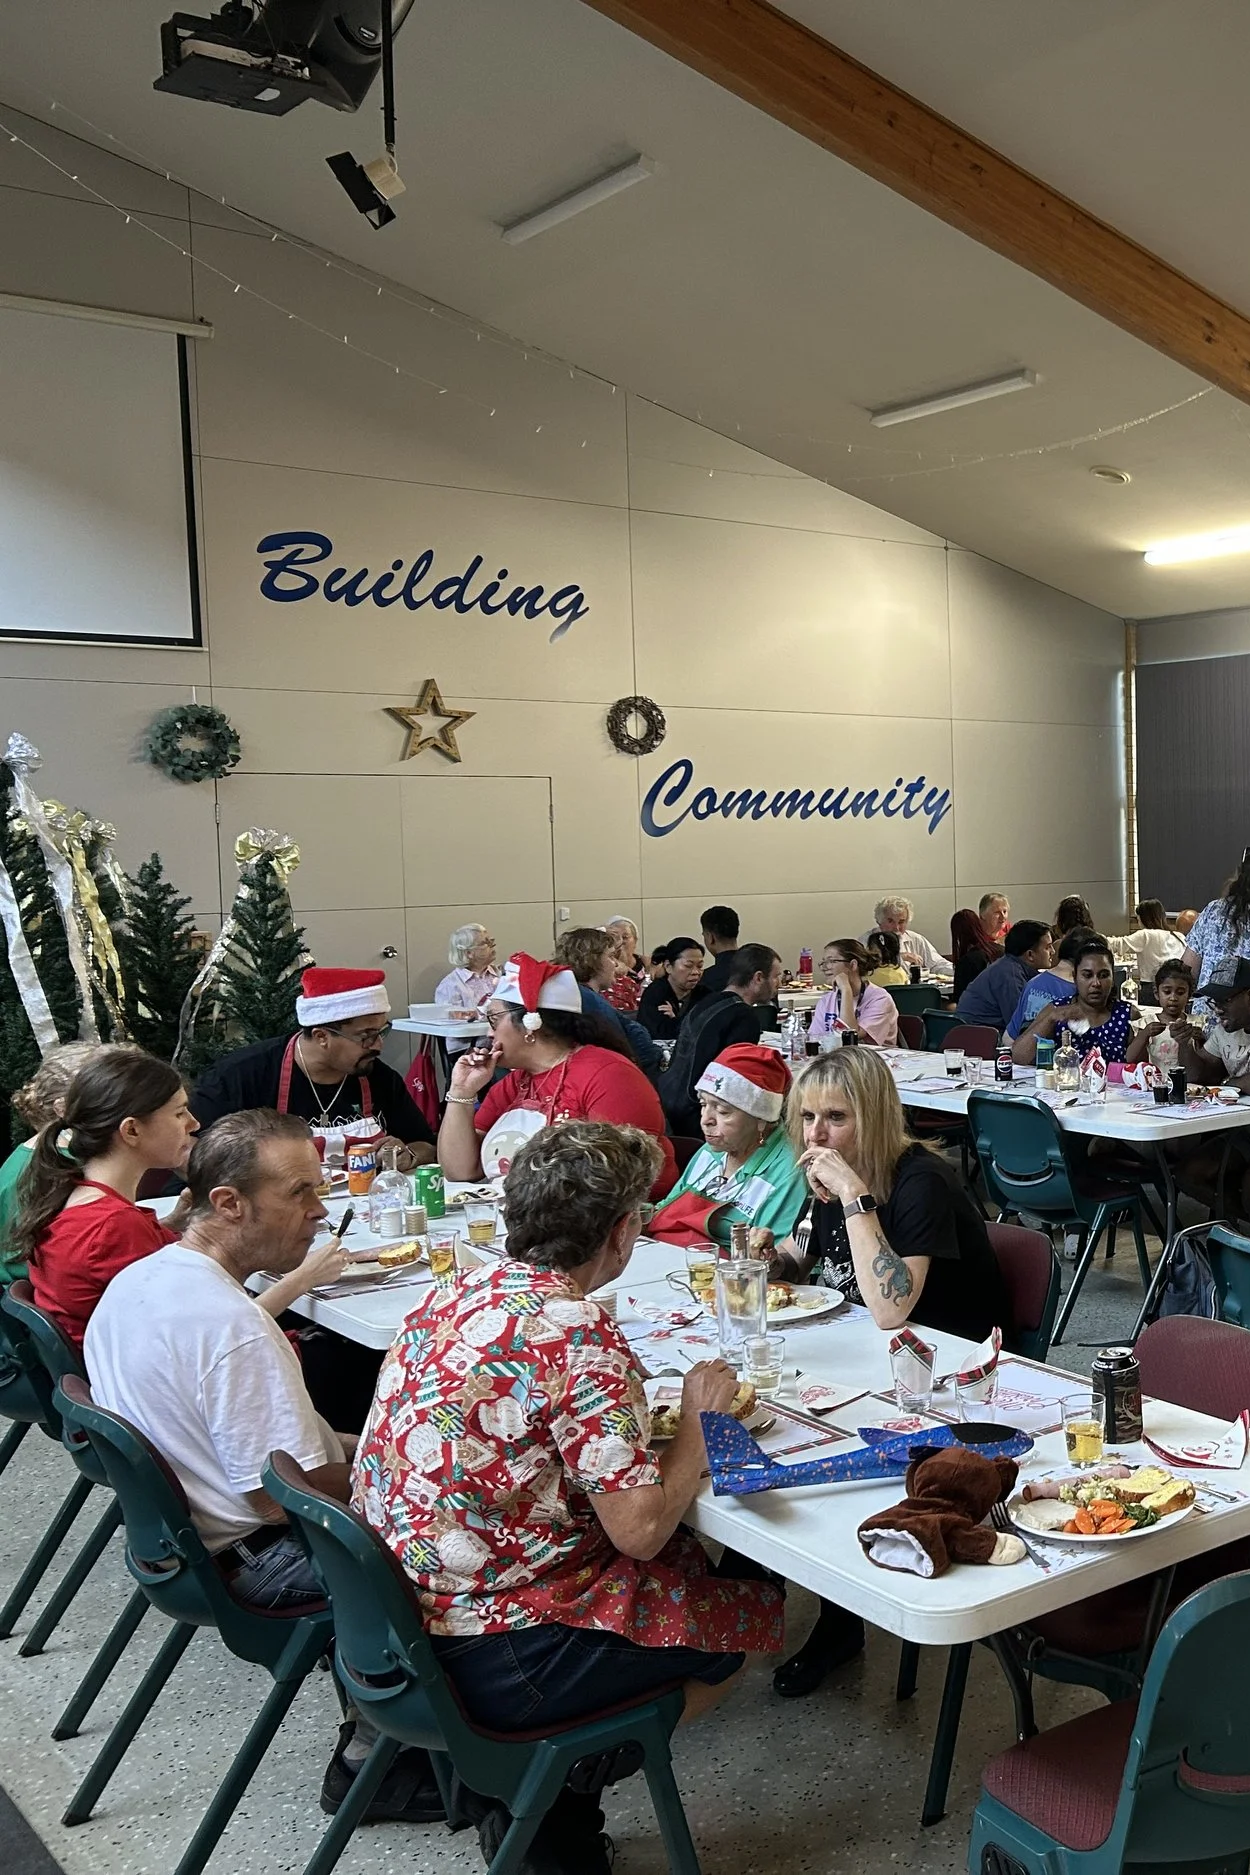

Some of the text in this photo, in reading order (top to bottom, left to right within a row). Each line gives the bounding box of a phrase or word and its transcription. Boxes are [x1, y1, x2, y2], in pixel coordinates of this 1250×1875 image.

[256, 531, 590, 644] Building
[640, 758, 952, 838] Community
[348, 1151, 376, 1169] FANT
[426, 1174, 445, 1192] Sp
